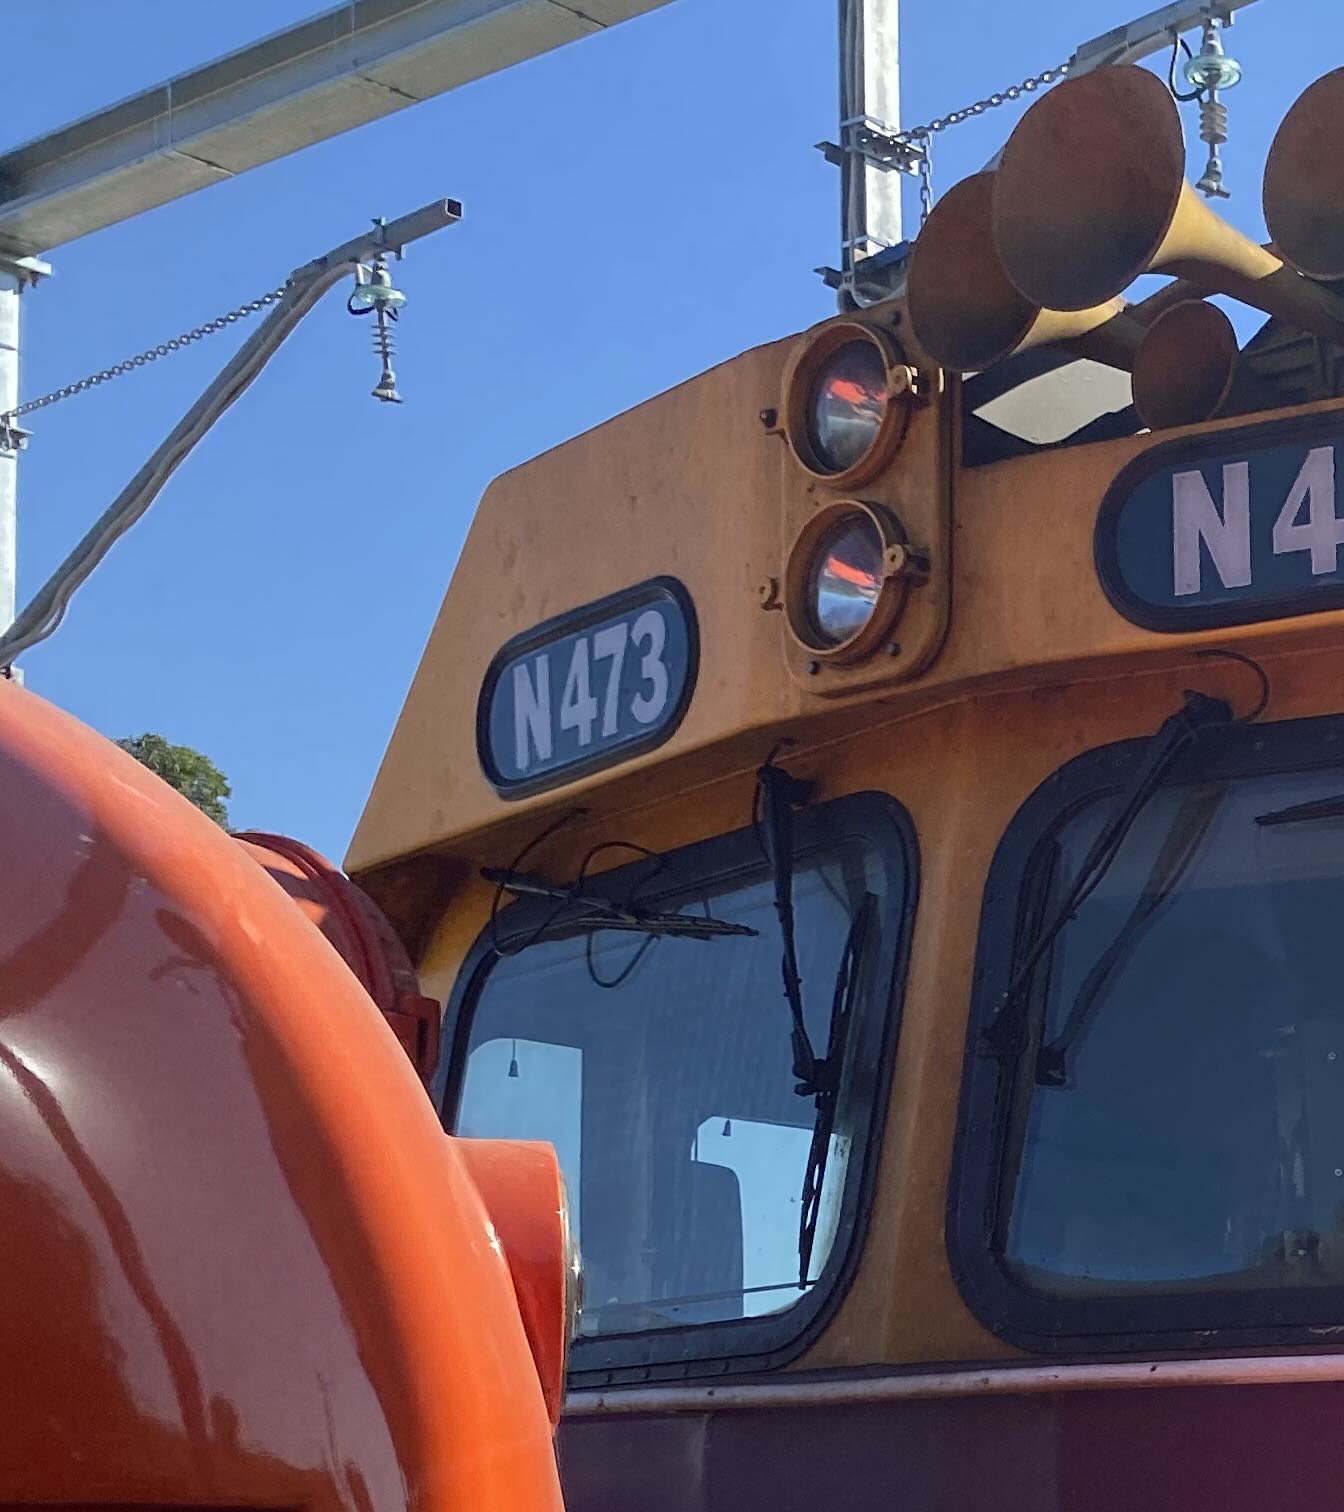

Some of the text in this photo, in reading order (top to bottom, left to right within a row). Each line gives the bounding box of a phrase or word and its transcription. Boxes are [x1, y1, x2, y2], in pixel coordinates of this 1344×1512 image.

[1172, 461, 1251, 596] N
[513, 610, 668, 771] N 473
